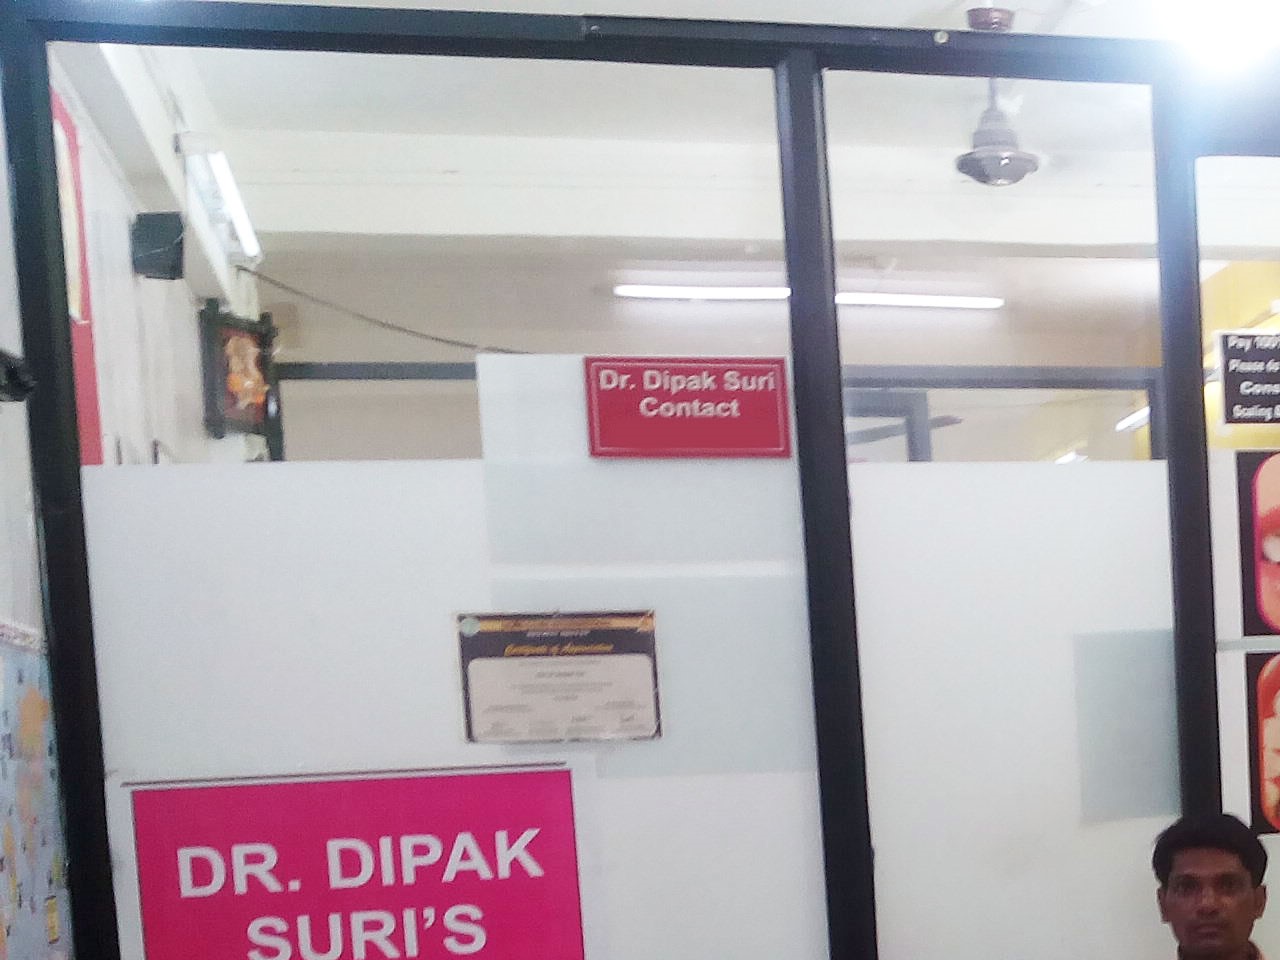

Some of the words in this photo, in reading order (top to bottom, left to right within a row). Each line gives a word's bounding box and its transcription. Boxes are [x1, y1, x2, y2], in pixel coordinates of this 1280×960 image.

[600, 368, 636, 391] Dr.
[643, 369, 717, 396] Dipak
[724, 370, 777, 391] Suri
[639, 397, 741, 418] Contact
[177, 842, 300, 898] DR.
[326, 827, 545, 890] DIPAK
